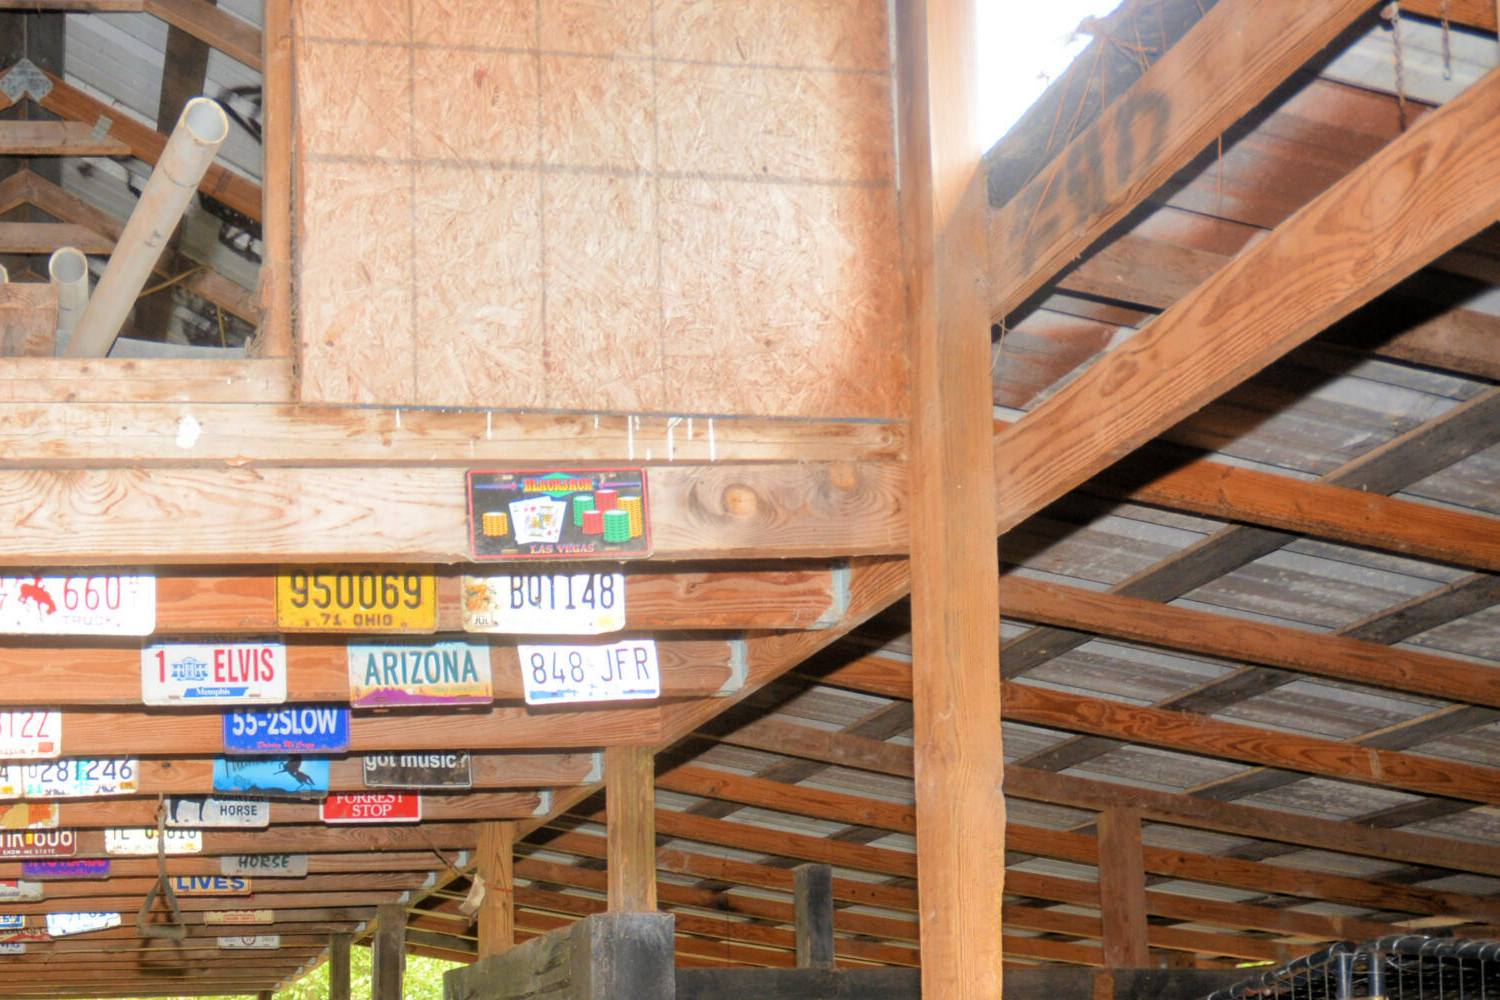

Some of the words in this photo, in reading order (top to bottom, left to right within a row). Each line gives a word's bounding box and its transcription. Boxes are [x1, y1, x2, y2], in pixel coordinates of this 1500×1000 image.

[523, 477, 594, 492] BLACKJACK
[530, 544, 554, 554] LAS
[557, 543, 596, 554] VEGAS
[63, 575, 121, 611] 660
[290, 570, 422, 610] 950069
[62, 615, 112, 626] TRUCK
[320, 613, 343, 626] 71
[353, 614, 394, 627] OHIO
[155, 650, 165, 683] 1
[213, 648, 275, 683] ELVIS
[364, 649, 480, 687] ARIZONA
[530, 650, 585, 685] 848
[601, 646, 651, 683] JFR
[195, 687, 231, 697] Memphis
[231, 707, 338, 736] 55-2SLOW
[400, 753, 468, 769] music?
[219, 805, 258, 816] HORSE
[351, 804, 393, 817] STOP
[237, 855, 291, 869] HORSE
[176, 876, 245, 891] LIVES
